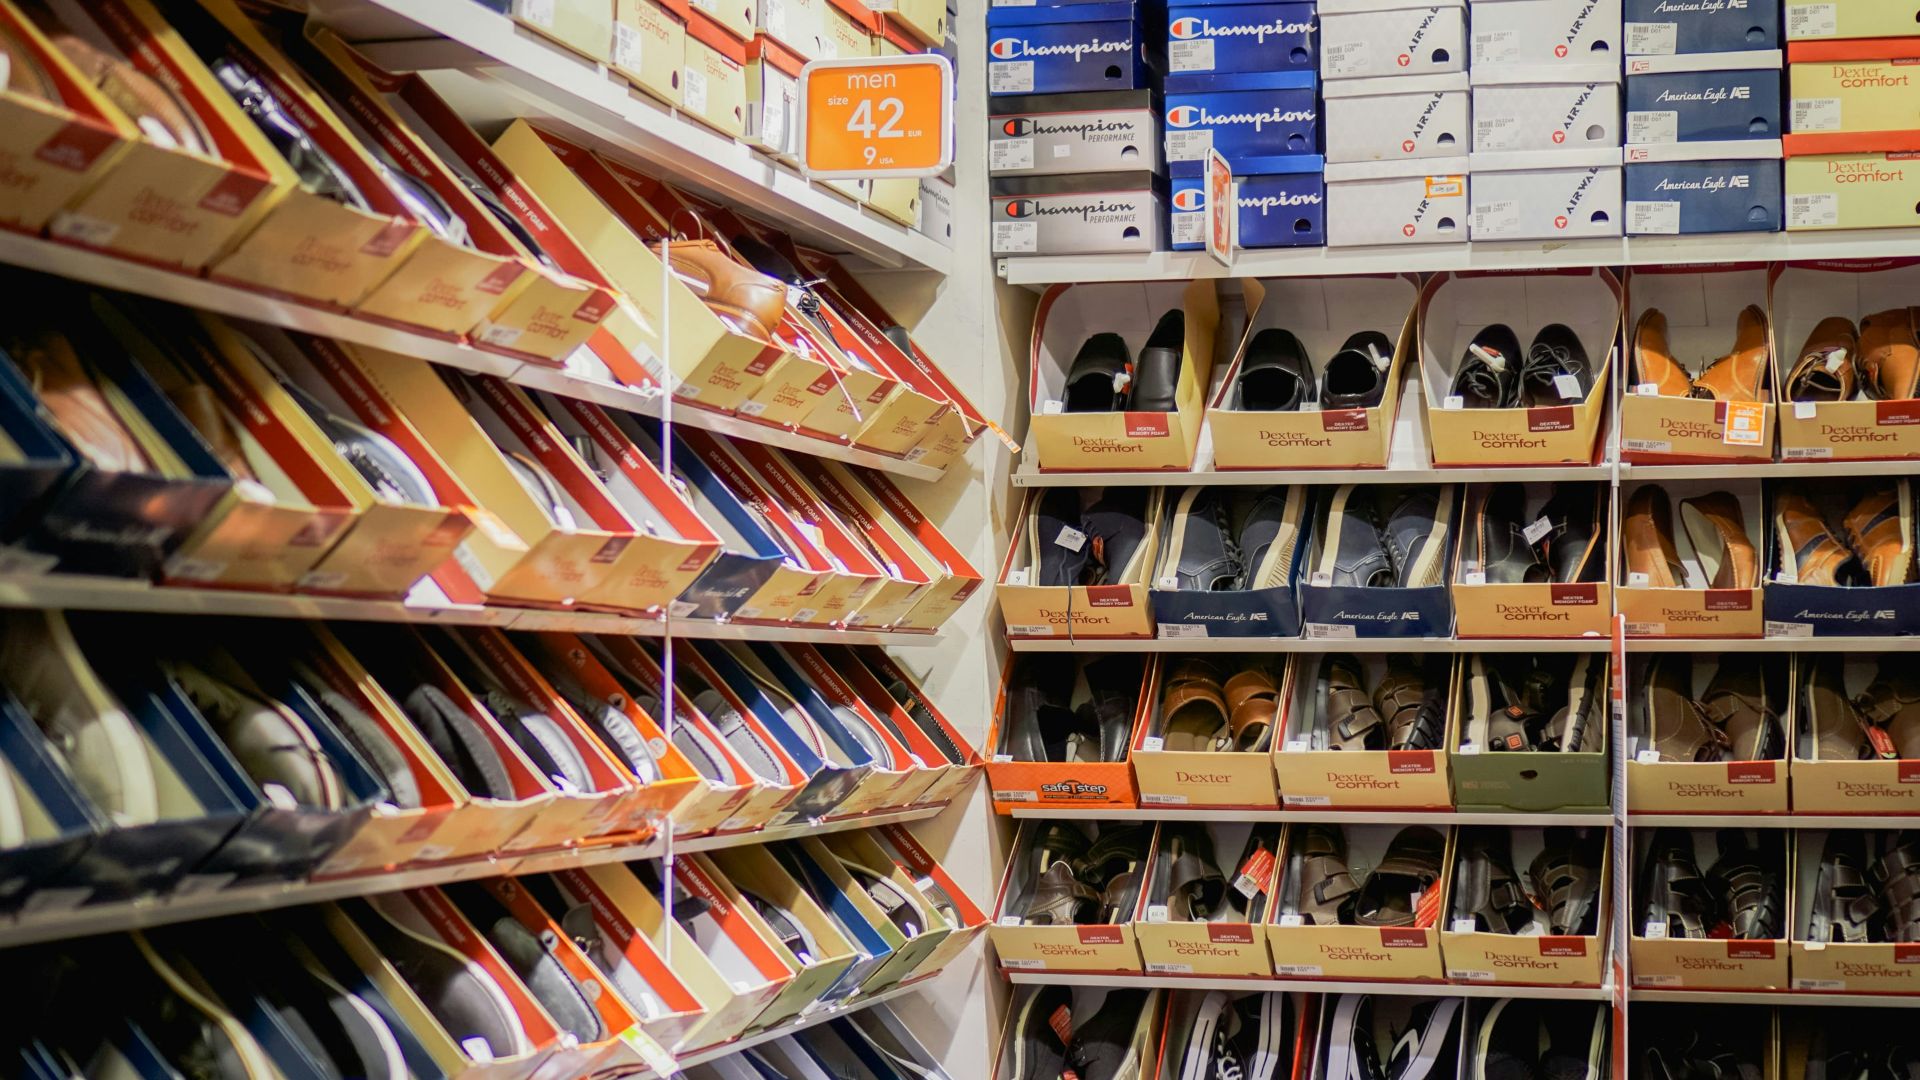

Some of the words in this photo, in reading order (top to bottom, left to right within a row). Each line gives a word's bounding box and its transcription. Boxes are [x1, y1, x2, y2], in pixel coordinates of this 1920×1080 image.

[1654, 1, 1700, 13] American
[1701, 0, 1725, 14] Eagle
[1169, 17, 1318, 44] Champion
[990, 37, 1133, 63] Champion
[1833, 66, 1880, 78] Dexter
[848, 72, 896, 89] men
[1841, 75, 1908, 88] comfort
[1656, 89, 1702, 103] American
[1703, 88, 1727, 104] Eagle
[828, 96, 848, 106] size
[847, 98, 905, 138] 42
[1166, 105, 1316, 133] Champion
[1003, 117, 1134, 140] Champion
[1088, 133, 1136, 143] PERFORMANCE
[864, 147, 876, 165] 9
[1828, 161, 1876, 173] Dexter
[1836, 170, 1903, 183] comfort
[1654, 178, 1701, 191] American
[1702, 176, 1726, 193] Eagle
[1172, 188, 1322, 216] Cmpion
[1006, 199, 1135, 222] Champion
[1089, 213, 1136, 224] PERFORMANCE
[1668, 429, 1724, 440] comfo
[1821, 424, 1872, 434] Dexter
[1074, 436, 1117, 446] Dexter
[1259, 431, 1305, 440] Dexter
[1473, 431, 1520, 440] Dexter
[1829, 432, 1898, 442] comfort
[1268, 438, 1332, 447] comfort
[1481, 439, 1547, 448] comfort
[1082, 444, 1143, 453] comfort
[765, 462, 786, 485] DEXTER
[784, 481, 807, 505] MEMORY
[803, 502, 821, 522] FOAM
[1496, 604, 1544, 613] Dexter
[1184, 612, 1224, 620] American
[1226, 612, 1247, 623] Eagle
[1333, 611, 1375, 619] American
[1376, 611, 1398, 622] Eagle
[1504, 612, 1570, 621] comfort
[1794, 609, 1844, 619] American
[1845, 611, 1870, 621] Eagle
[1176, 771, 1232, 783] Dexter
[1327, 772, 1374, 782] Dexter
[1336, 780, 1400, 788] comfort
[1669, 782, 1718, 790] Dexter
[1677, 789, 1744, 797] comfort
[1845, 789, 1914, 797] comfort
[686, 871, 711, 897] MEMORY
[709, 895, 728, 916] FOAM
[1168, 940, 1213, 949] Dexter
[1320, 944, 1366, 953] Dexter
[1177, 948, 1240, 956] comfort
[1328, 953, 1393, 961] comfort
[1485, 951, 1532, 961] Dexter
[1493, 961, 1559, 969] comfort
